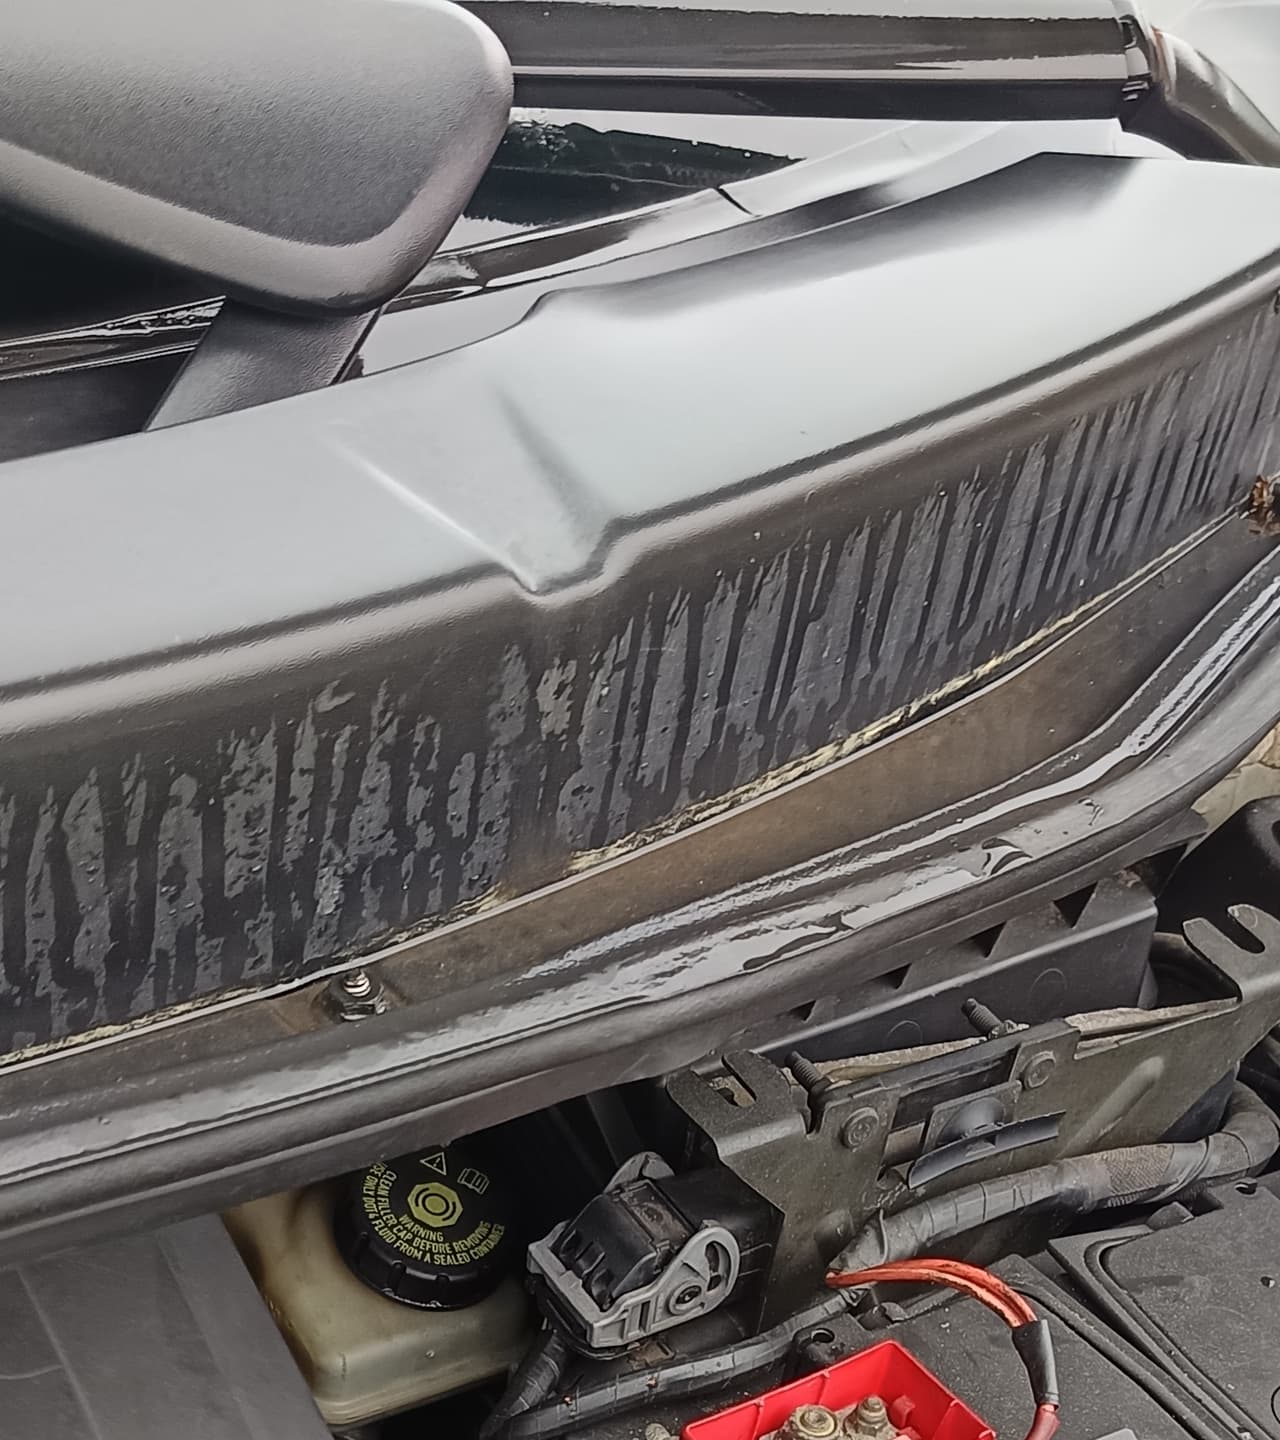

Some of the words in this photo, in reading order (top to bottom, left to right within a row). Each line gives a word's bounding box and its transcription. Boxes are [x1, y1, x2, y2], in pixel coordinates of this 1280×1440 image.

[376, 1170, 397, 1197] CLEAN
[363, 1175, 379, 1197] ONLY
[371, 1219, 397, 1243] FLUID
[393, 1240, 423, 1261] FROM
[423, 1252, 432, 1264] A
[433, 1252, 472, 1266] SEALED
[469, 1223, 505, 1260] CONTAINER
[376, 1197, 398, 1227] FILLER
[393, 1225, 414, 1241] CAP
[399, 1214, 444, 1242] WARNING
[452, 1220, 492, 1253] REMOVING
[412, 1236, 453, 1254] BEFORE
